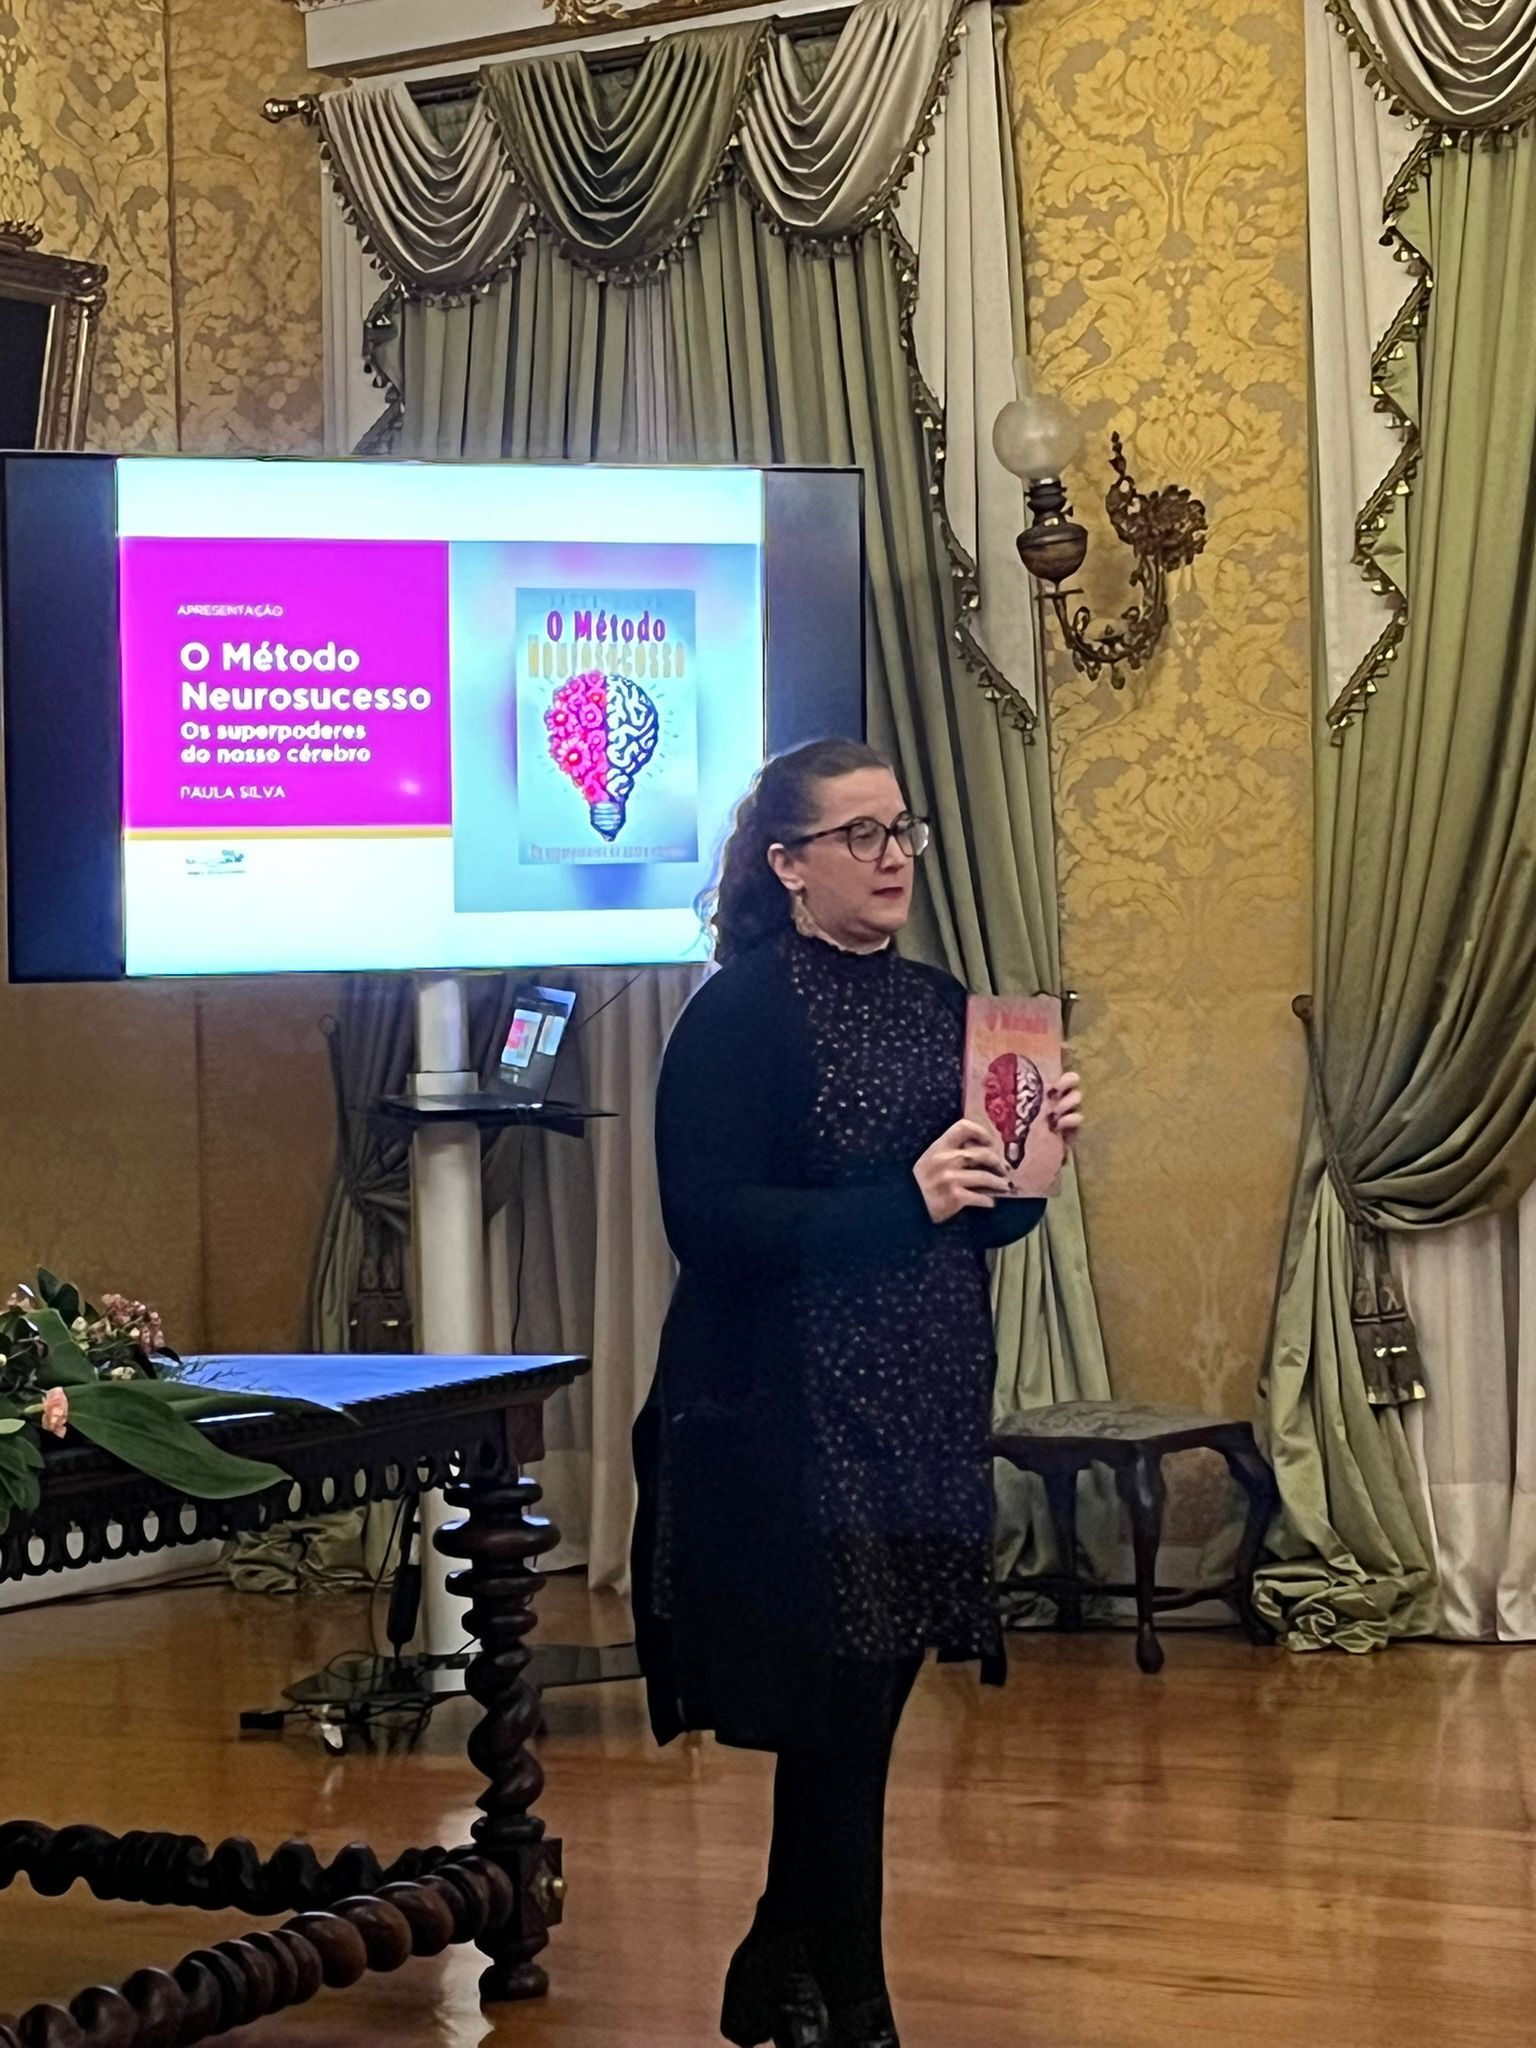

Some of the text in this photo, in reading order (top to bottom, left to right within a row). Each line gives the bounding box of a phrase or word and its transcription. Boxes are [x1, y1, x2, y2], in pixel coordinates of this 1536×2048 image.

[177, 603, 284, 618] APRESENTAÇÃO
[546, 609, 666, 643] O Método
[180, 640, 360, 672] O Método
[181, 681, 432, 712] Neurosucesso
[180, 720, 367, 744] Os superpoderes
[180, 743, 372, 764] do nosso cérebro
[180, 785, 286, 800] PAULA SILVA
